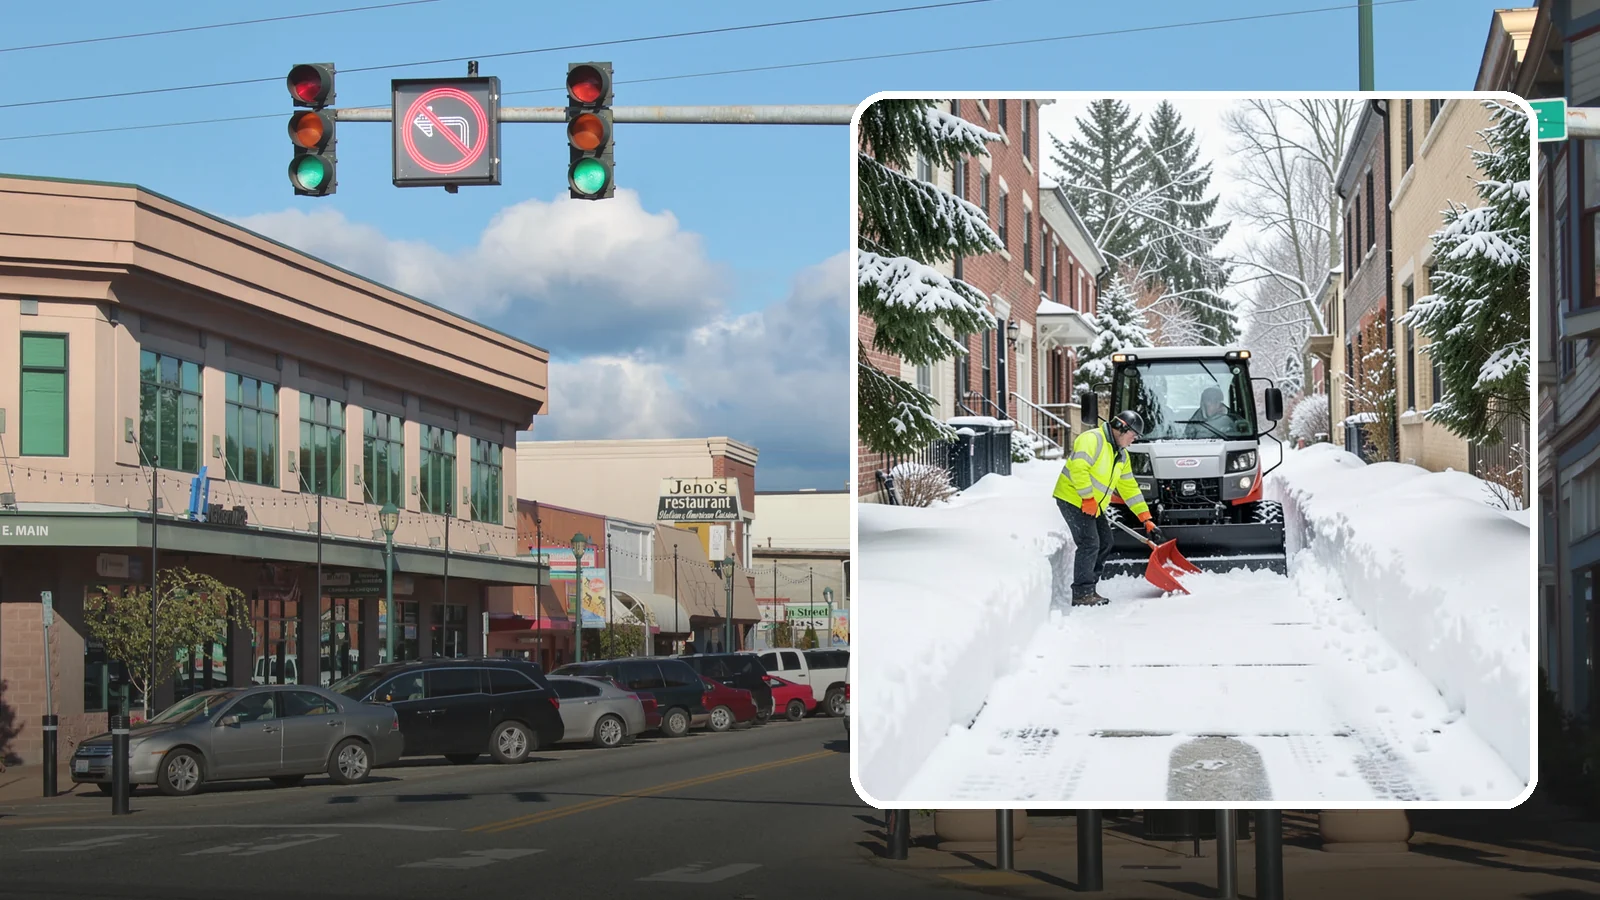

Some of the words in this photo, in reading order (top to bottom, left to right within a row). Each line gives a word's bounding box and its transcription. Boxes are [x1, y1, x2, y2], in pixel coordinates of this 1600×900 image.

[670, 480, 727, 494] Jeno's
[665, 496, 731, 509] restaurant
[658, 510, 681, 519] Italian
[686, 510, 714, 519] American
[715, 509, 737, 519] Cuisine
[2, 525, 13, 536] E.
[15, 525, 49, 536] MAIN
[798, 608, 828, 616] Street
[790, 619, 824, 627] lass
